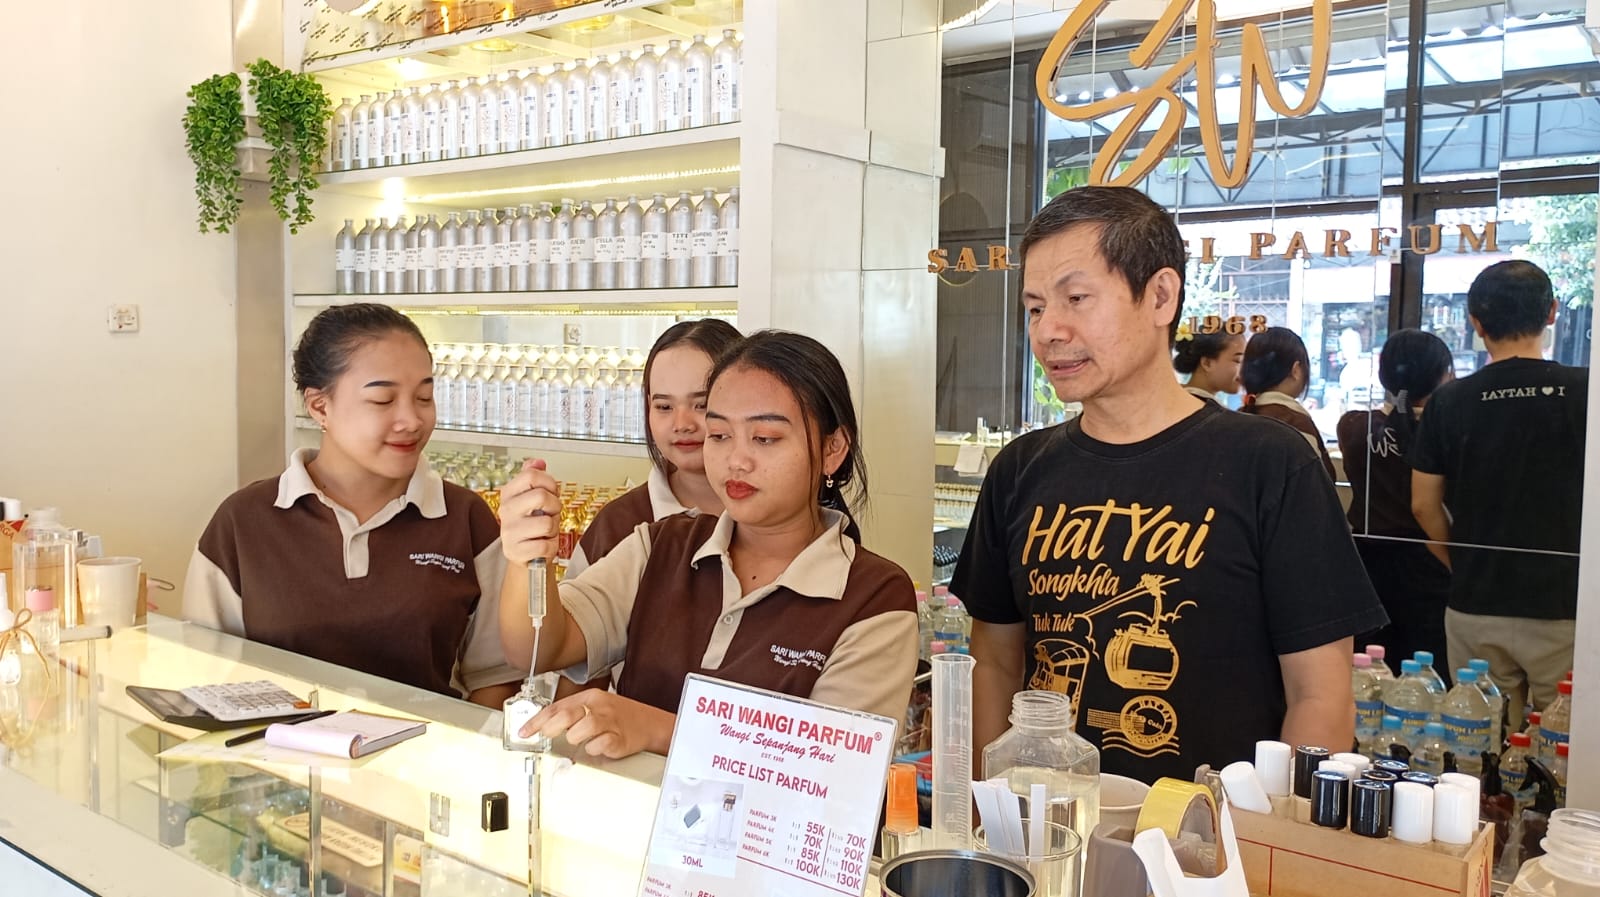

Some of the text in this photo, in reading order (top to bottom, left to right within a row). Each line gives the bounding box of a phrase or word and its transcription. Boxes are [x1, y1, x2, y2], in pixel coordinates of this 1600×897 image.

[927, 244, 1016, 274] SAR
[1248, 221, 1499, 261] PARFUM
[1188, 314, 1268, 336] 1968
[1123, 503, 1216, 569] Yai
[1028, 563, 1121, 601] Songkhla
[1033, 611, 1076, 633] Tuk Tuk
[770, 645, 788, 655] SARI
[696, 696, 734, 720] SARI
[738, 706, 794, 735] WANGI
[720, 723, 836, 763] Wangi Sepanjang Hari
[712, 755, 828, 799] PRICE LIST PARFUM
[804, 834, 823, 850] 70K
[844, 847, 864, 863] 90K
[806, 821, 825, 837] 55K
[846, 833, 867, 849] 70K
[682, 855, 703, 868] 30ML
[796, 859, 821, 877] 100K
[836, 872, 861, 890] 130K
[801, 847, 821, 863] 85K
[840, 859, 862, 876] 110K
